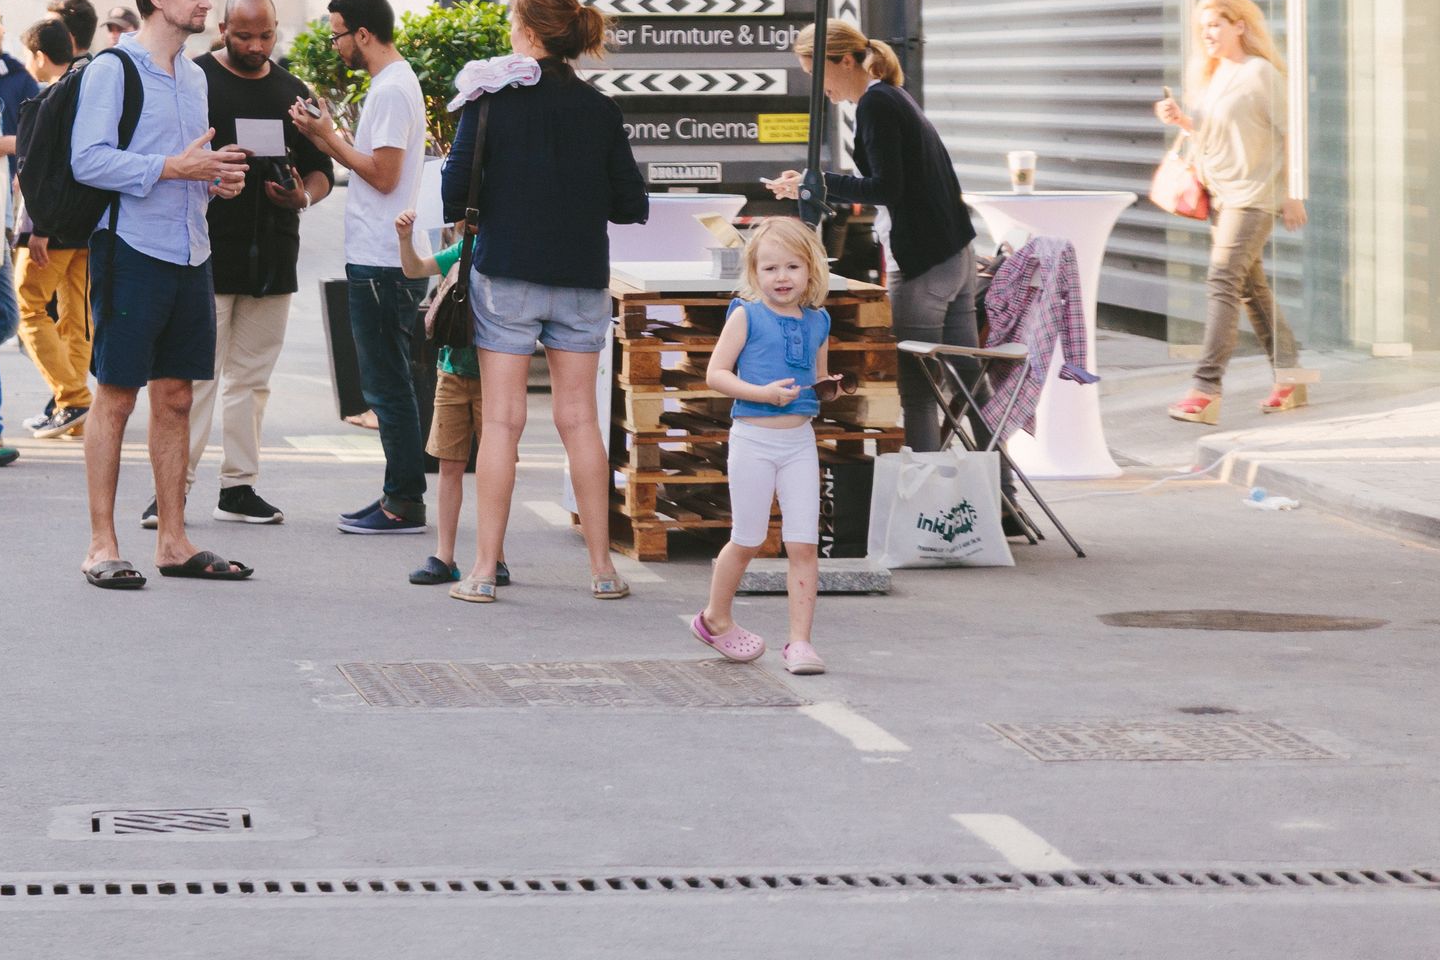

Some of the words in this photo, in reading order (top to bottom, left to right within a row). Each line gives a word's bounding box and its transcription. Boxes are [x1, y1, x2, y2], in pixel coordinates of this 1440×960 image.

[641, 24, 734, 46] Furniture
[737, 24, 754, 45] &
[759, 24, 801, 51] Ligh
[623, 122, 671, 139] ome
[675, 117, 759, 139] Cinema
[650, 166, 719, 180] DHOLLANDIA
